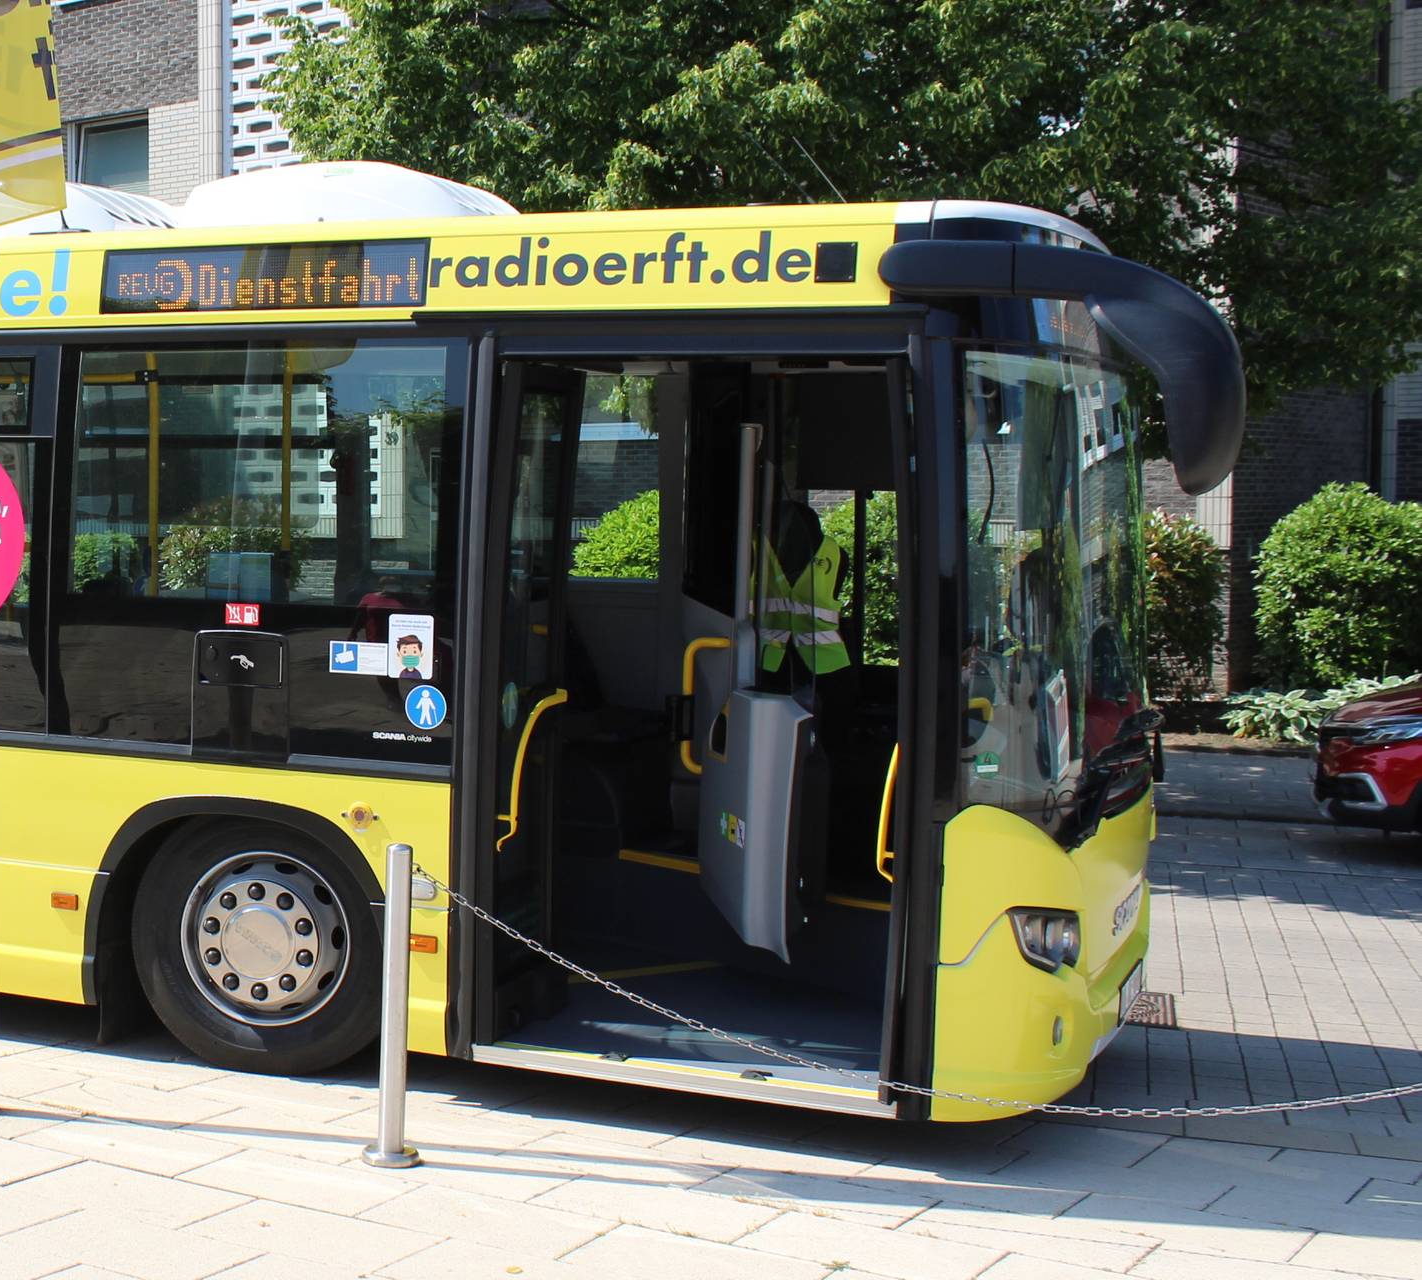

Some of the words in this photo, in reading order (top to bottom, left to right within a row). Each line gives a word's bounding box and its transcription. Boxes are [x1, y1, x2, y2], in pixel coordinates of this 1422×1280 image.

[197, 255, 421, 306] Dienstfahrt
[428, 229, 812, 288] radioerft.de
[372, 731, 407, 741] SCANIA
